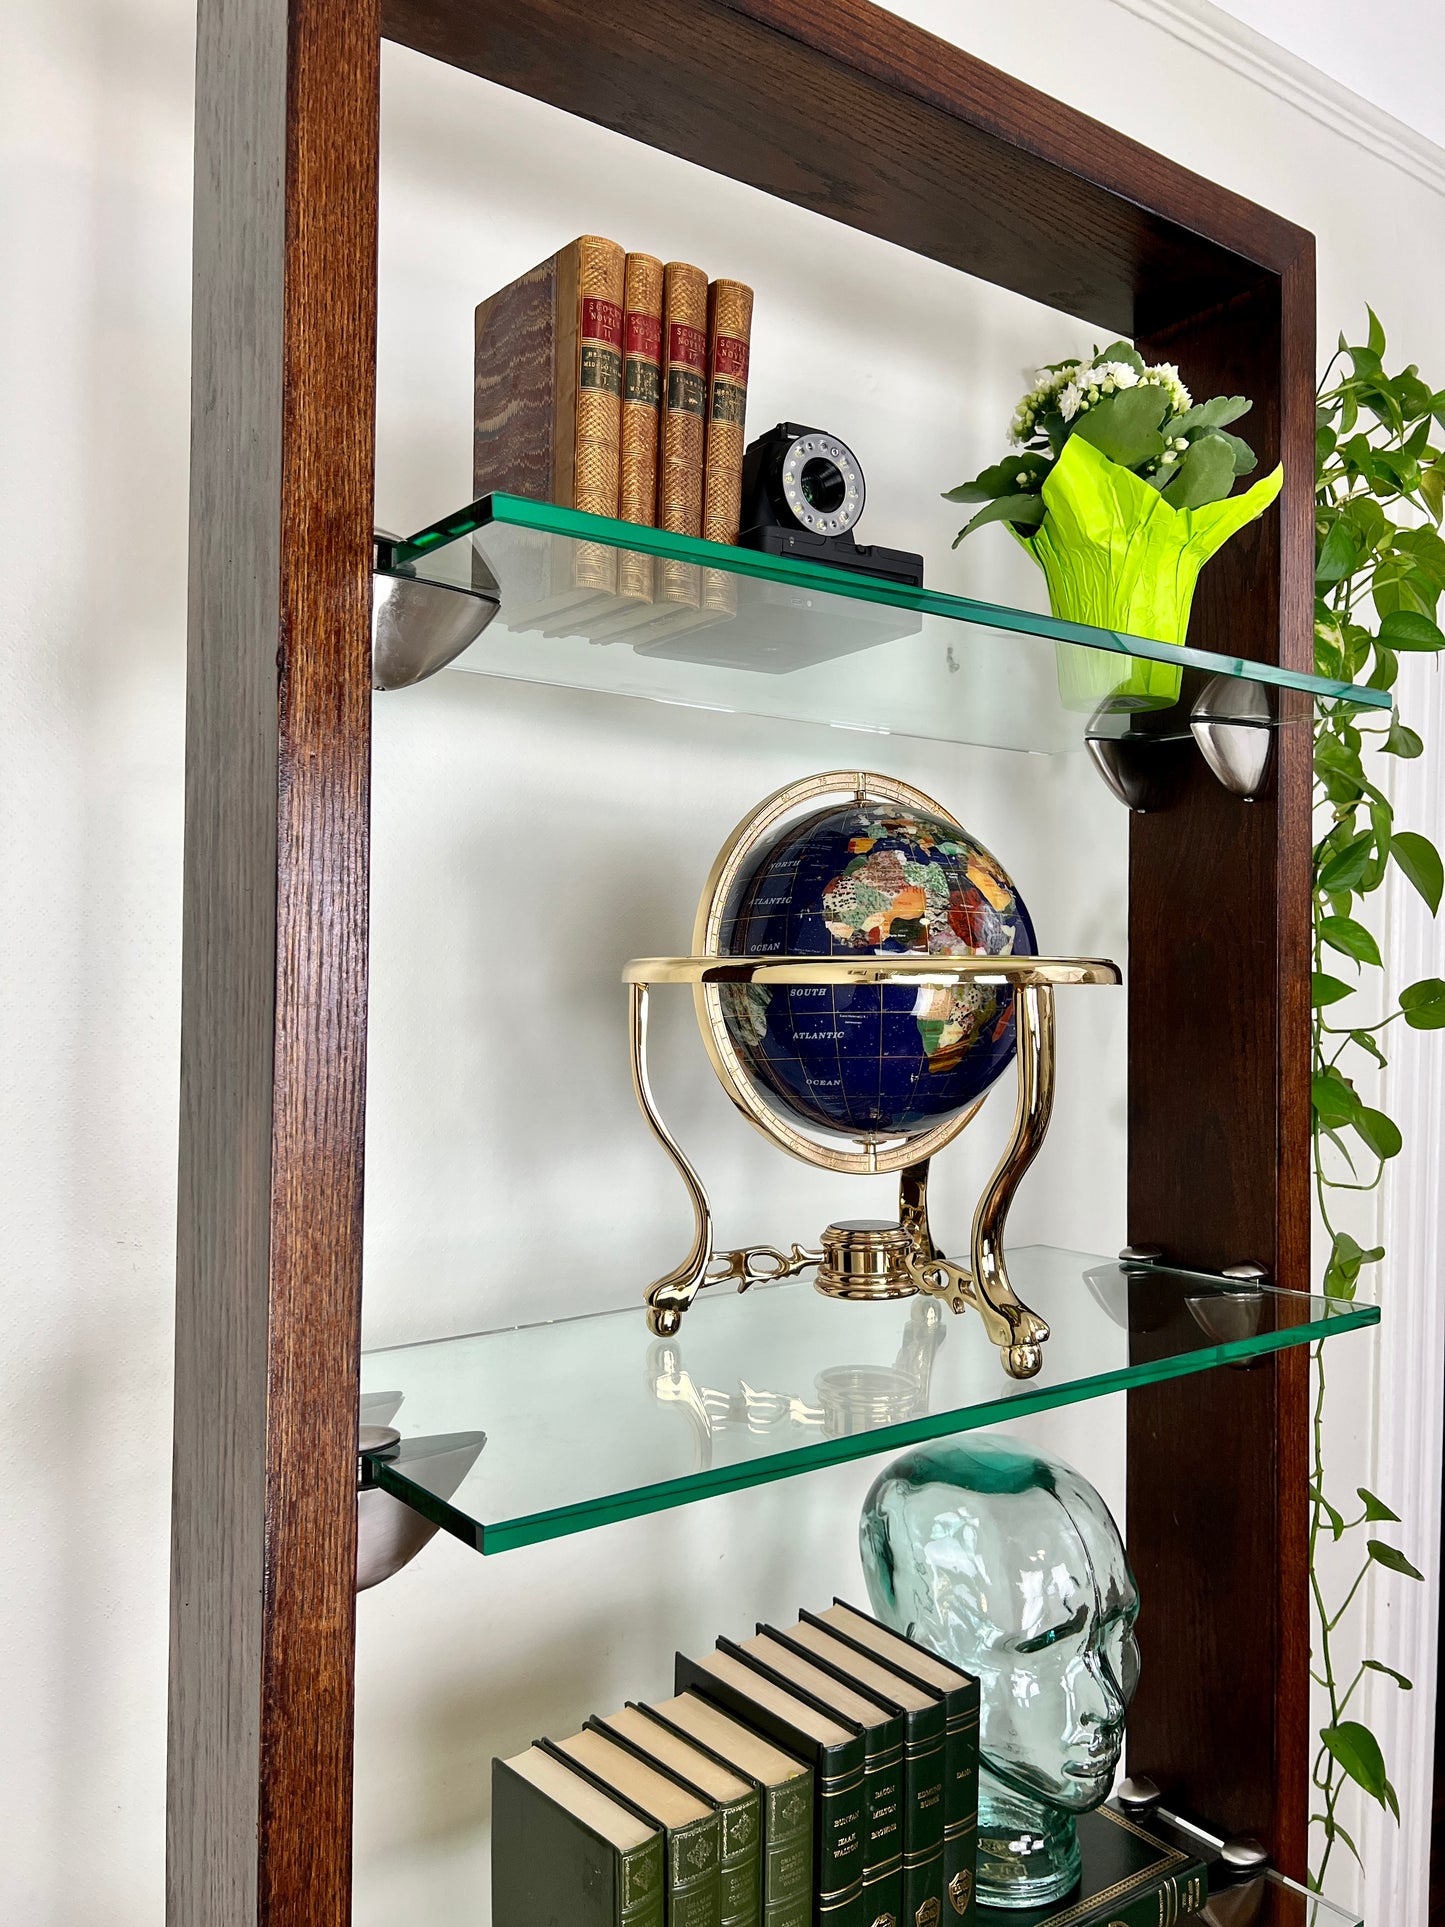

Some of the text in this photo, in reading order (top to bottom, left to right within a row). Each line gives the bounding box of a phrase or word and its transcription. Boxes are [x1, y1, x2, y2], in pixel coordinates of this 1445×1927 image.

[769, 859, 801, 870] NORTH
[749, 895, 793, 906] ATLANTIC
[750, 941, 781, 952] OCEAN
[789, 987, 827, 997] SOUTH
[792, 1030, 845, 1041] ATLANTIC
[805, 1078, 842, 1087] OCEAN
[874, 1785, 896, 1799] BACON
[872, 1803, 897, 1820] MILTON
[833, 1810, 860, 1828] BUNYAN
[833, 1841, 859, 1859] WALTON
